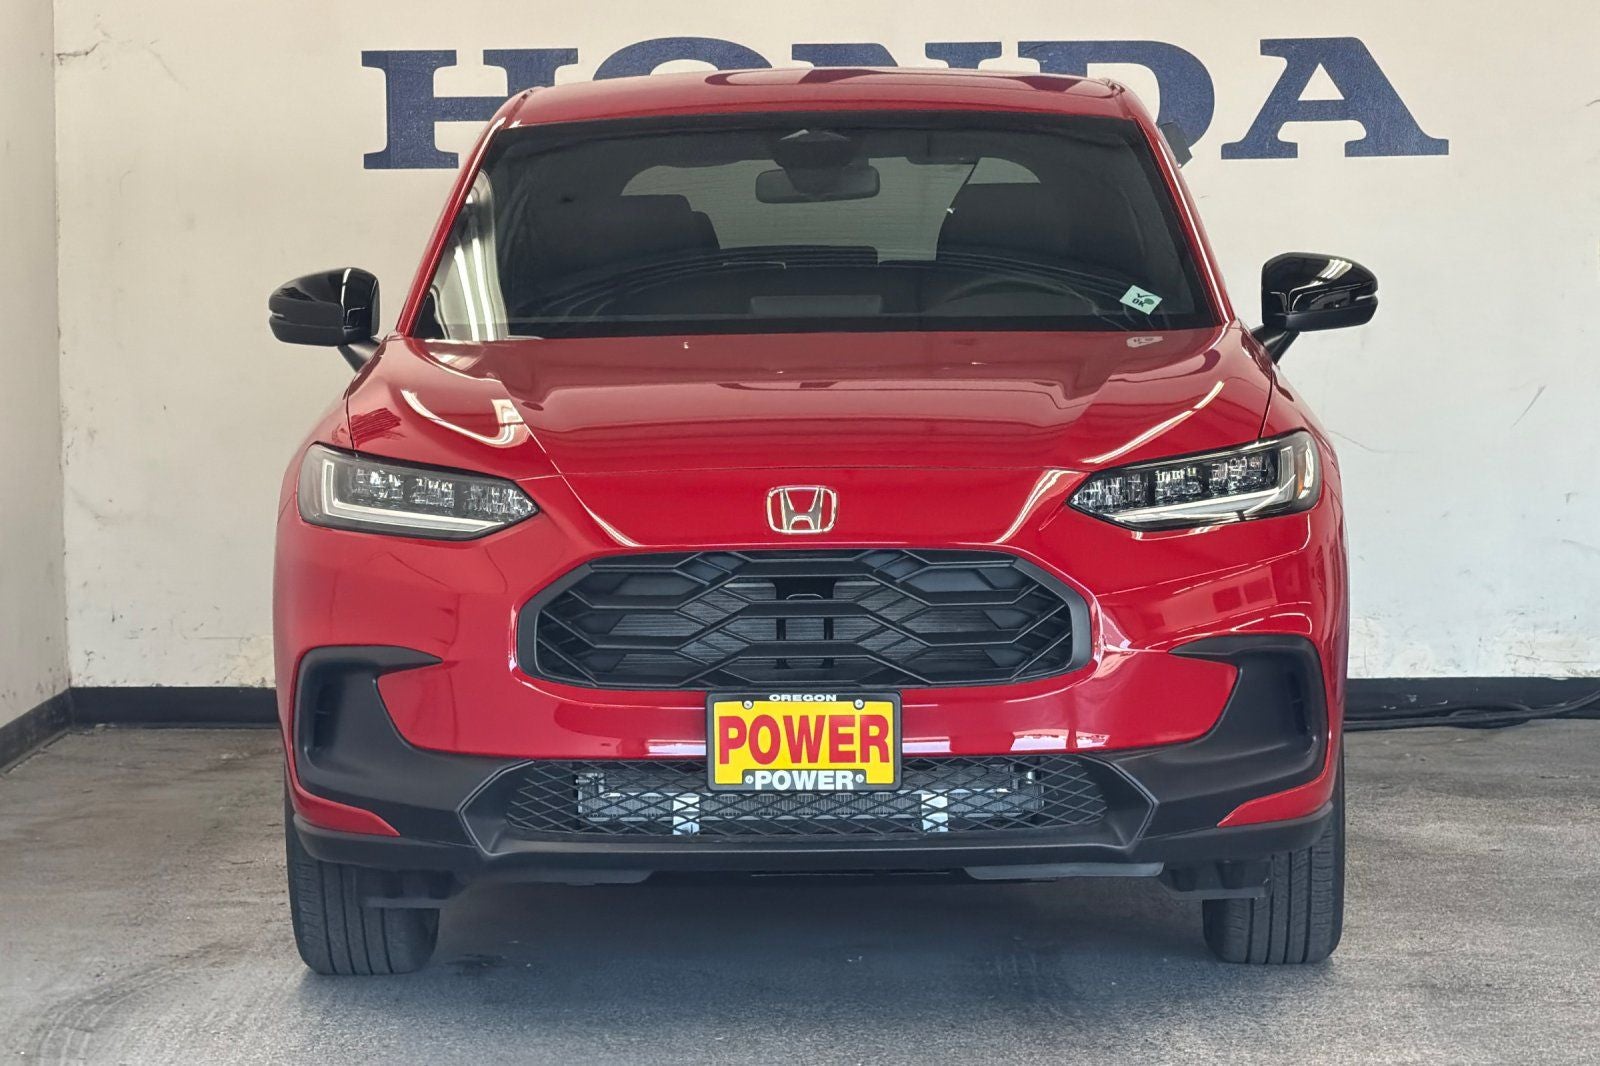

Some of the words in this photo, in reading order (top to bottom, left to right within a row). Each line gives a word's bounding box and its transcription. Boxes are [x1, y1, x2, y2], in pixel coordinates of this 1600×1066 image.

[361, 36, 1449, 170] HDA
[1132, 298, 1145, 307] OK
[769, 694, 837, 702] OREGON
[719, 714, 890, 764] POWER
[754, 770, 854, 790] POWER
